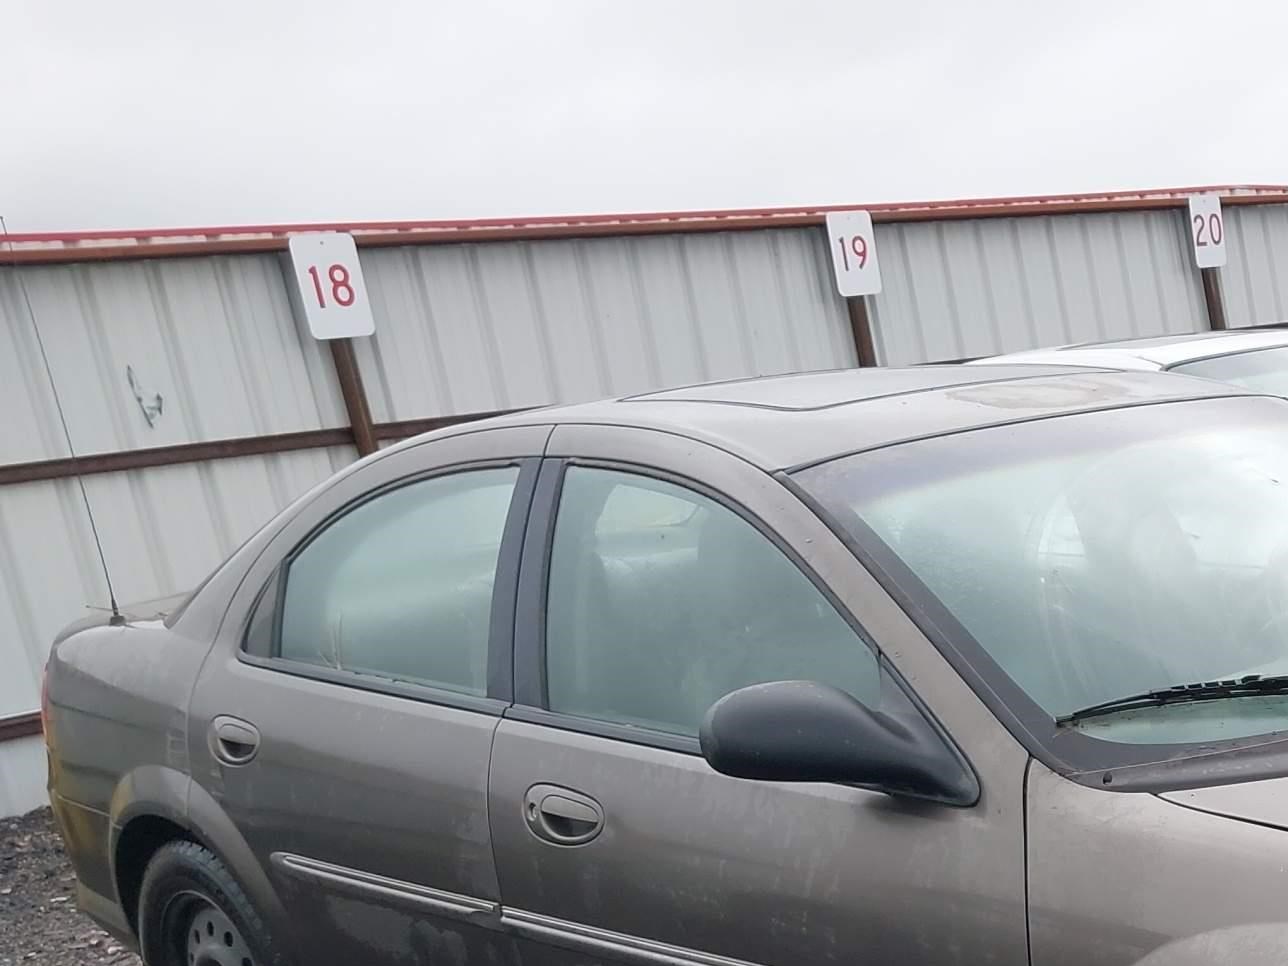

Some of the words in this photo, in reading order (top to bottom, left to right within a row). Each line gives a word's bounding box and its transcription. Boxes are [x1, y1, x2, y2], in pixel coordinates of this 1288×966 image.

[1193, 213, 1222, 247] 20
[839, 235, 867, 271] 19
[308, 264, 355, 309] 18
